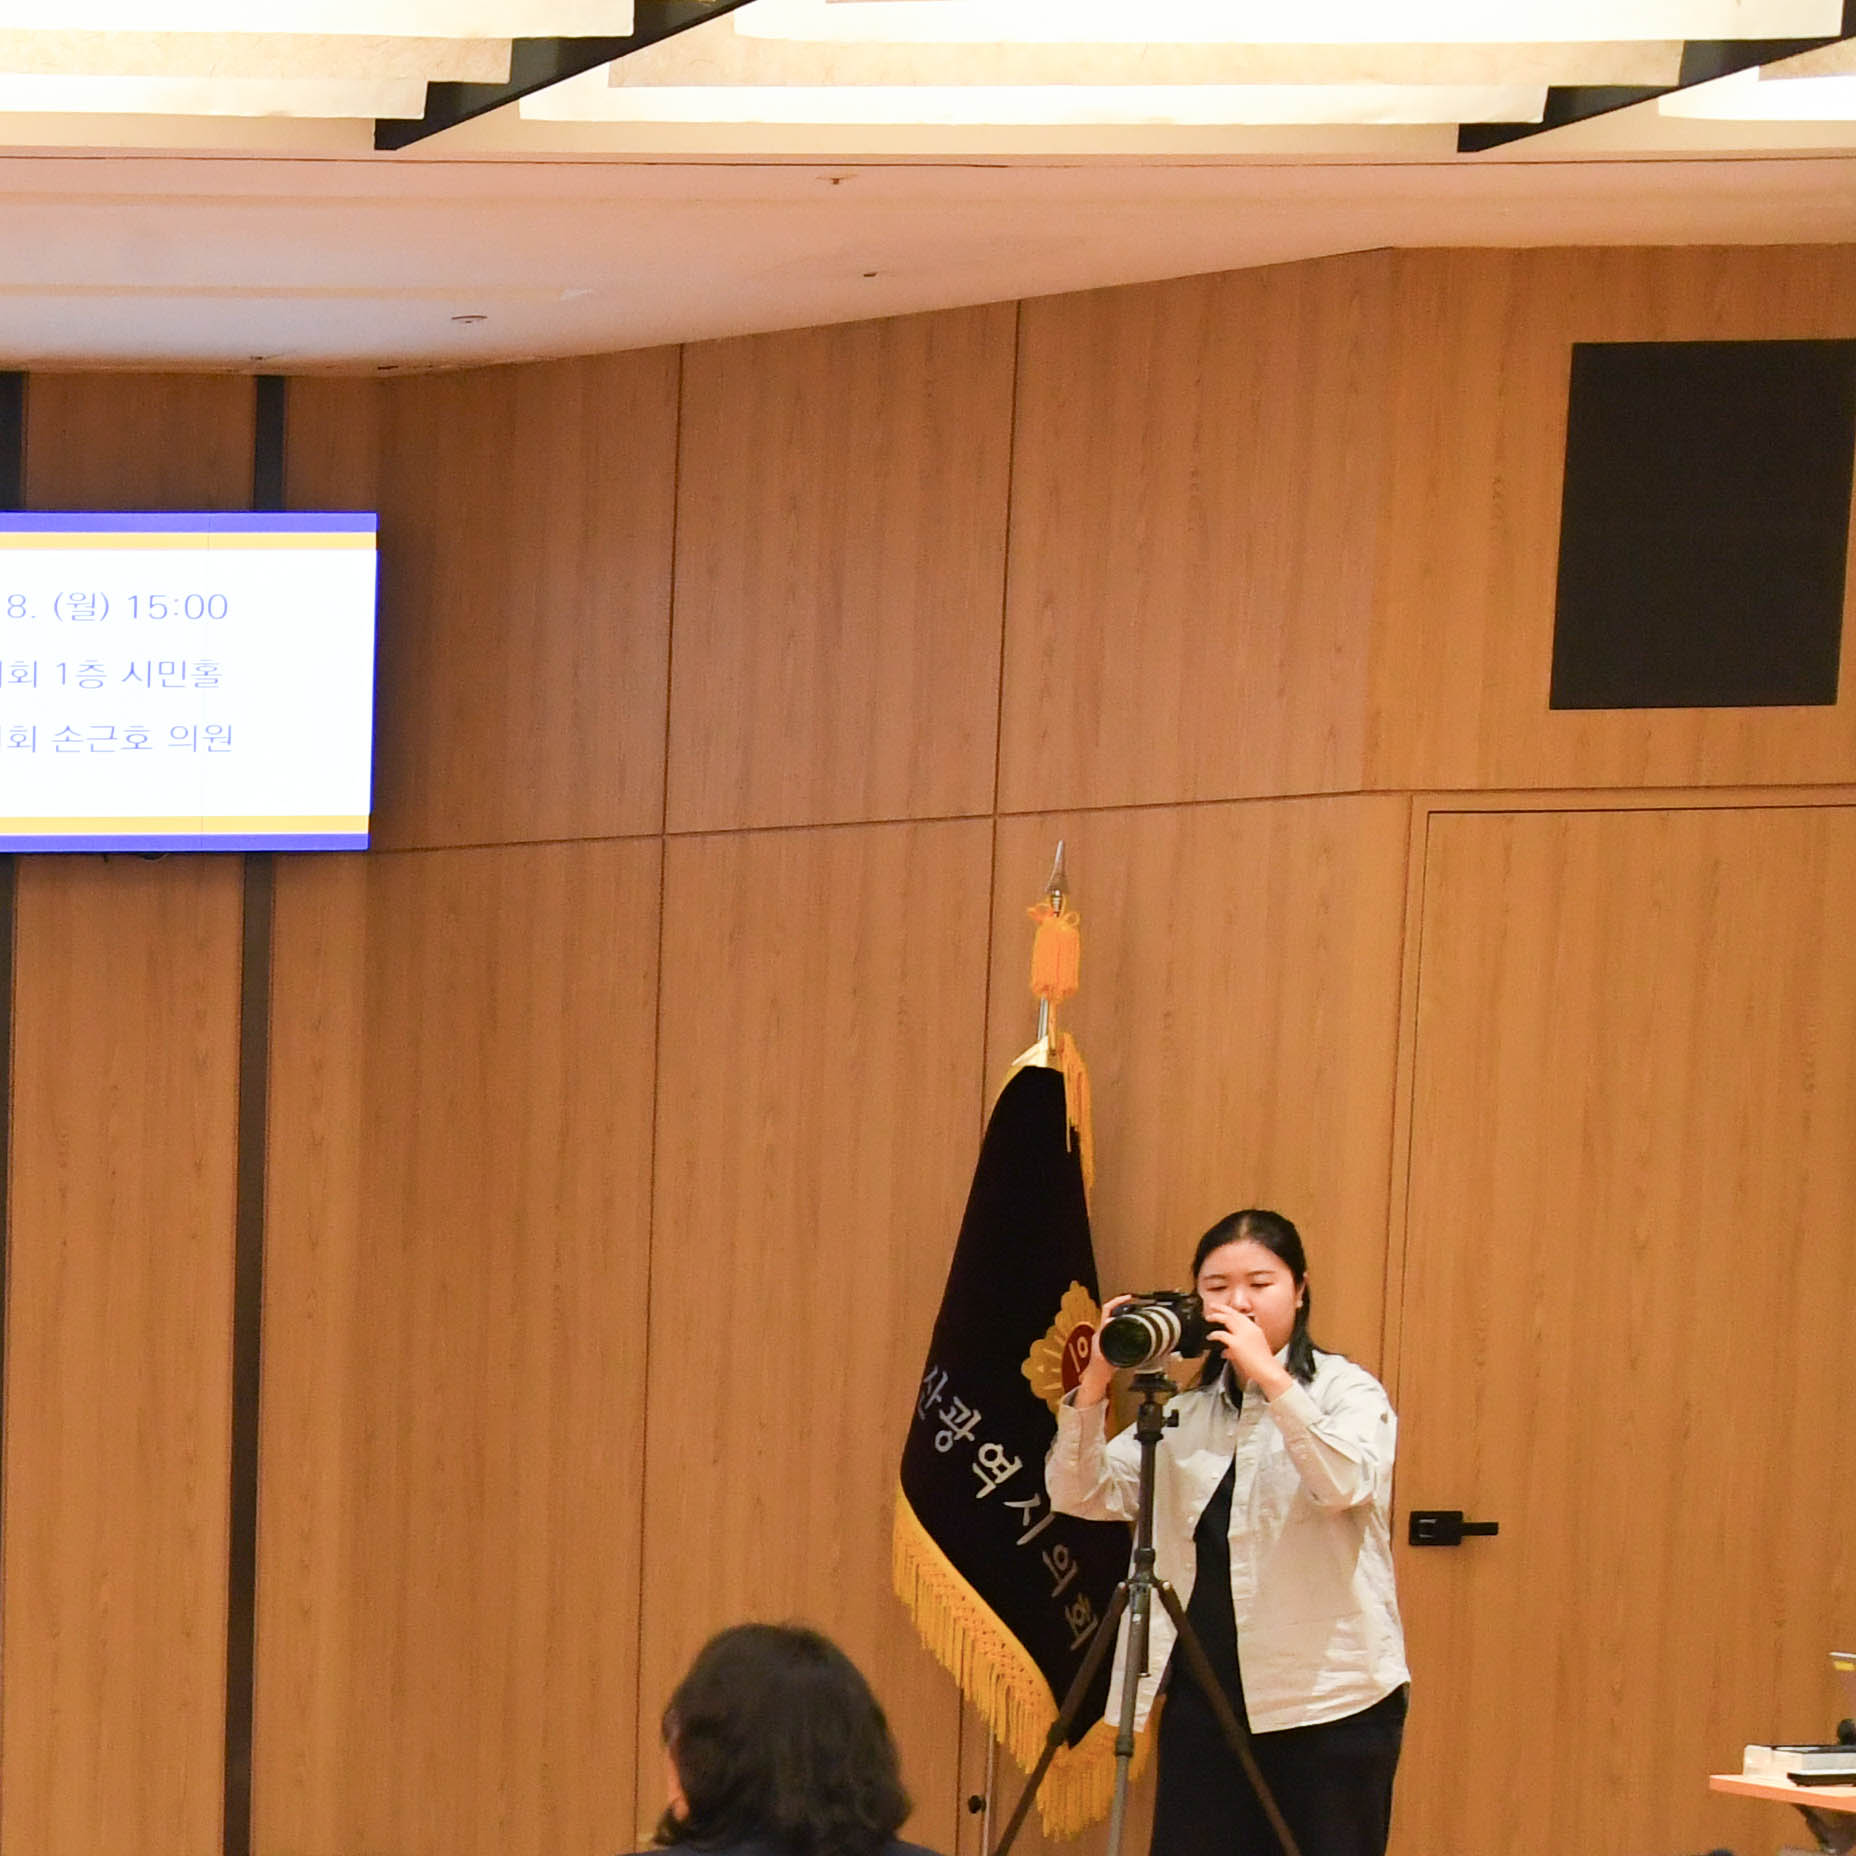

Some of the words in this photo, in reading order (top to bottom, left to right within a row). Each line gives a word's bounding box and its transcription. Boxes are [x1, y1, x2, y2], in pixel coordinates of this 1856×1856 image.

[54, 592, 109, 621] (월)
[128, 594, 228, 620] 15:00
[57, 660, 106, 688] 1층
[121, 660, 221, 688] 시민홀
[52, 725, 152, 752] 손근호
[168, 725, 232, 752] 의원
